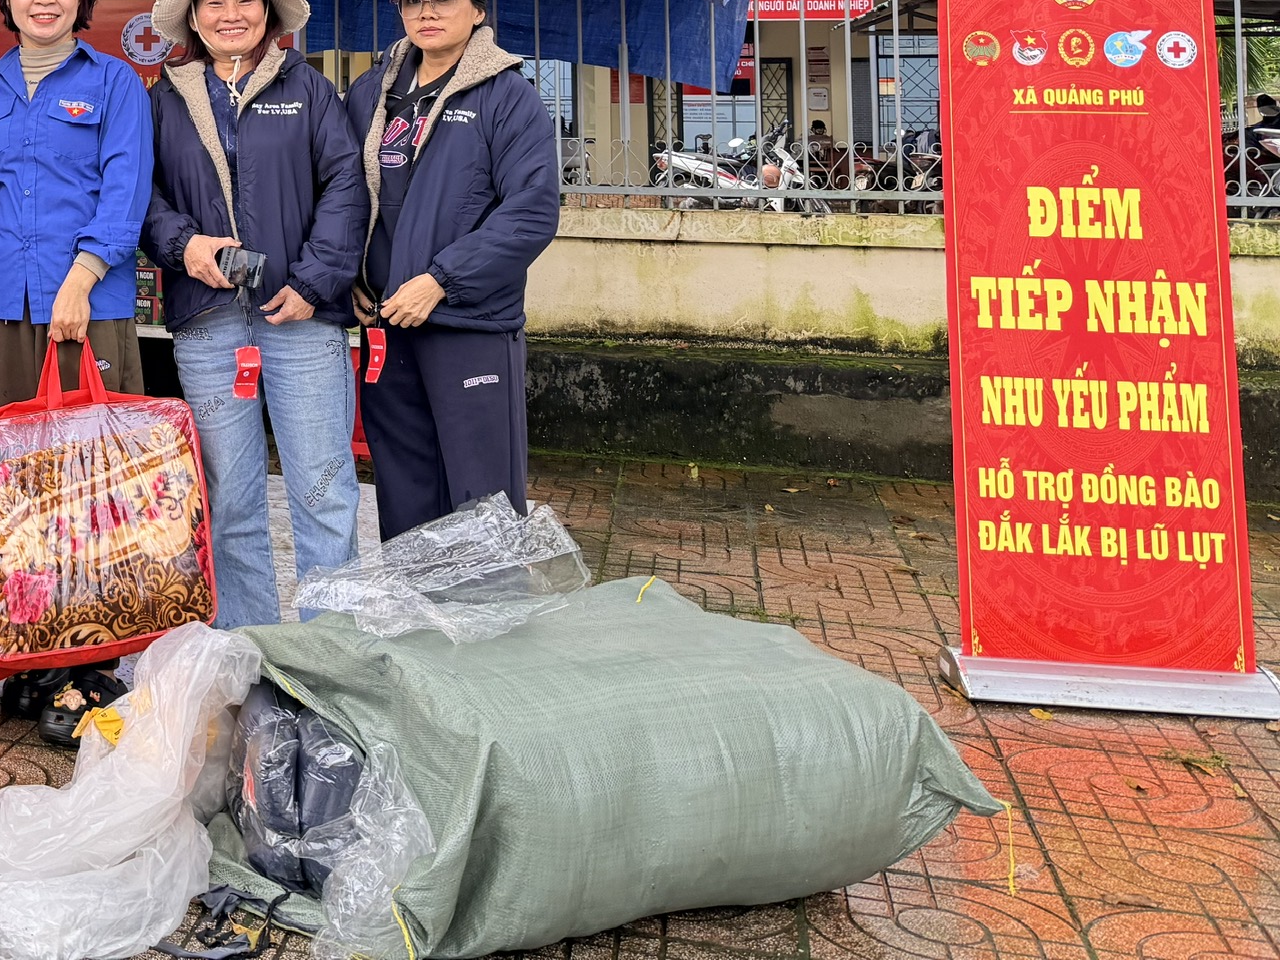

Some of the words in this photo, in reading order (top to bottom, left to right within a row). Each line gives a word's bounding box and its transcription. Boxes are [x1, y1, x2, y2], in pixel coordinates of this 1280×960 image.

[807, 1, 836, 11] DOANH
[1012, 86, 1038, 105] XÃ
[1043, 83, 1103, 106] QUẢNG
[1109, 86, 1144, 106] PHÚ
[1027, 164, 1143, 240] ĐIỂM
[970, 259, 1073, 331] TIẾP
[1085, 269, 1207, 348] NHẬN
[980, 375, 1043, 427] NHU
[1052, 362, 1107, 430] YẾU
[1117, 362, 1210, 433] PHẨM
[978, 457, 1015, 500] HỖ
[1022, 469, 1074, 509] TRỢ
[1081, 462, 1157, 507] ĐỒNG
[1165, 471, 1220, 509] BÀO
[978, 510, 1034, 553] ĐẮK
[1042, 513, 1092, 557] LẮK
[1100, 526, 1128, 566] BỊ
[1136, 523, 1168, 560] LŨ
[1177, 530, 1226, 570] LỤT
